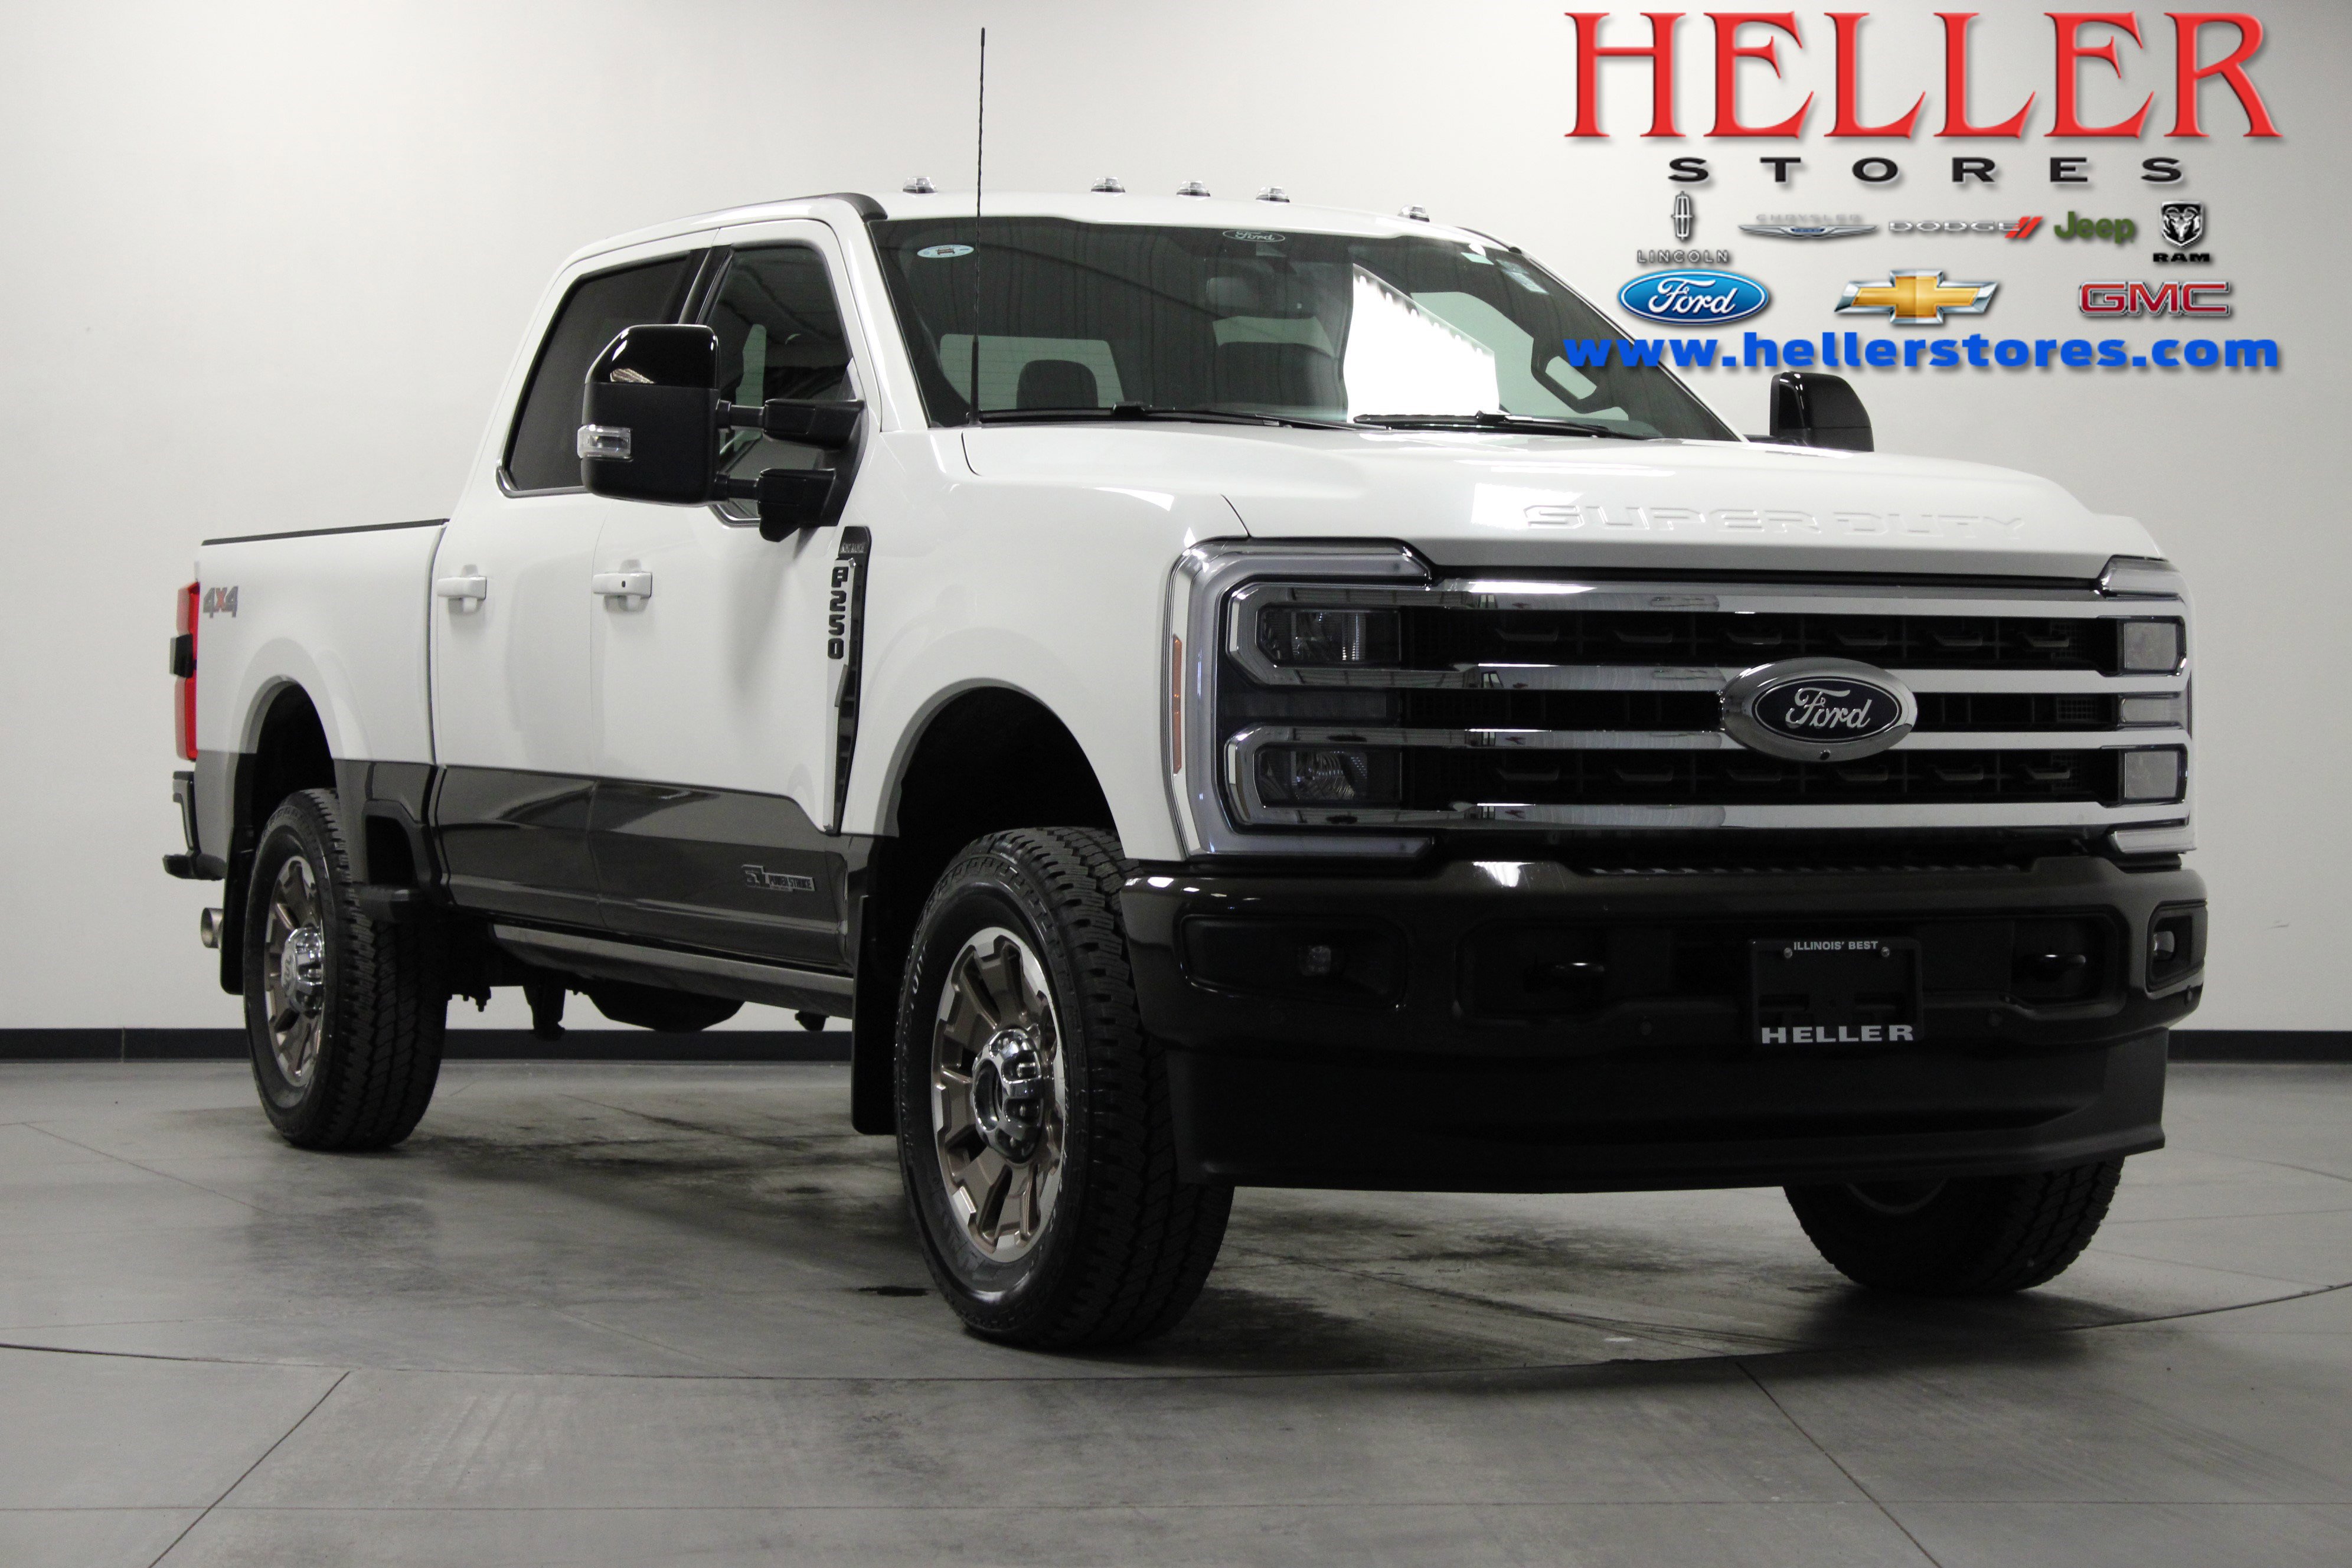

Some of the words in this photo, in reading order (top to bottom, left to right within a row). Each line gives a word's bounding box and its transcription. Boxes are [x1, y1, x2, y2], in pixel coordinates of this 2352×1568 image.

[1234, 230, 1275, 240] Ford
[1523, 504, 1822, 534] SUPER
[1833, 511, 2026, 540] DUTY
[1785, 687, 1873, 729] Ford
[1848, 940, 1879, 950] BEST
[1762, 1024, 1914, 1044] HELLER
